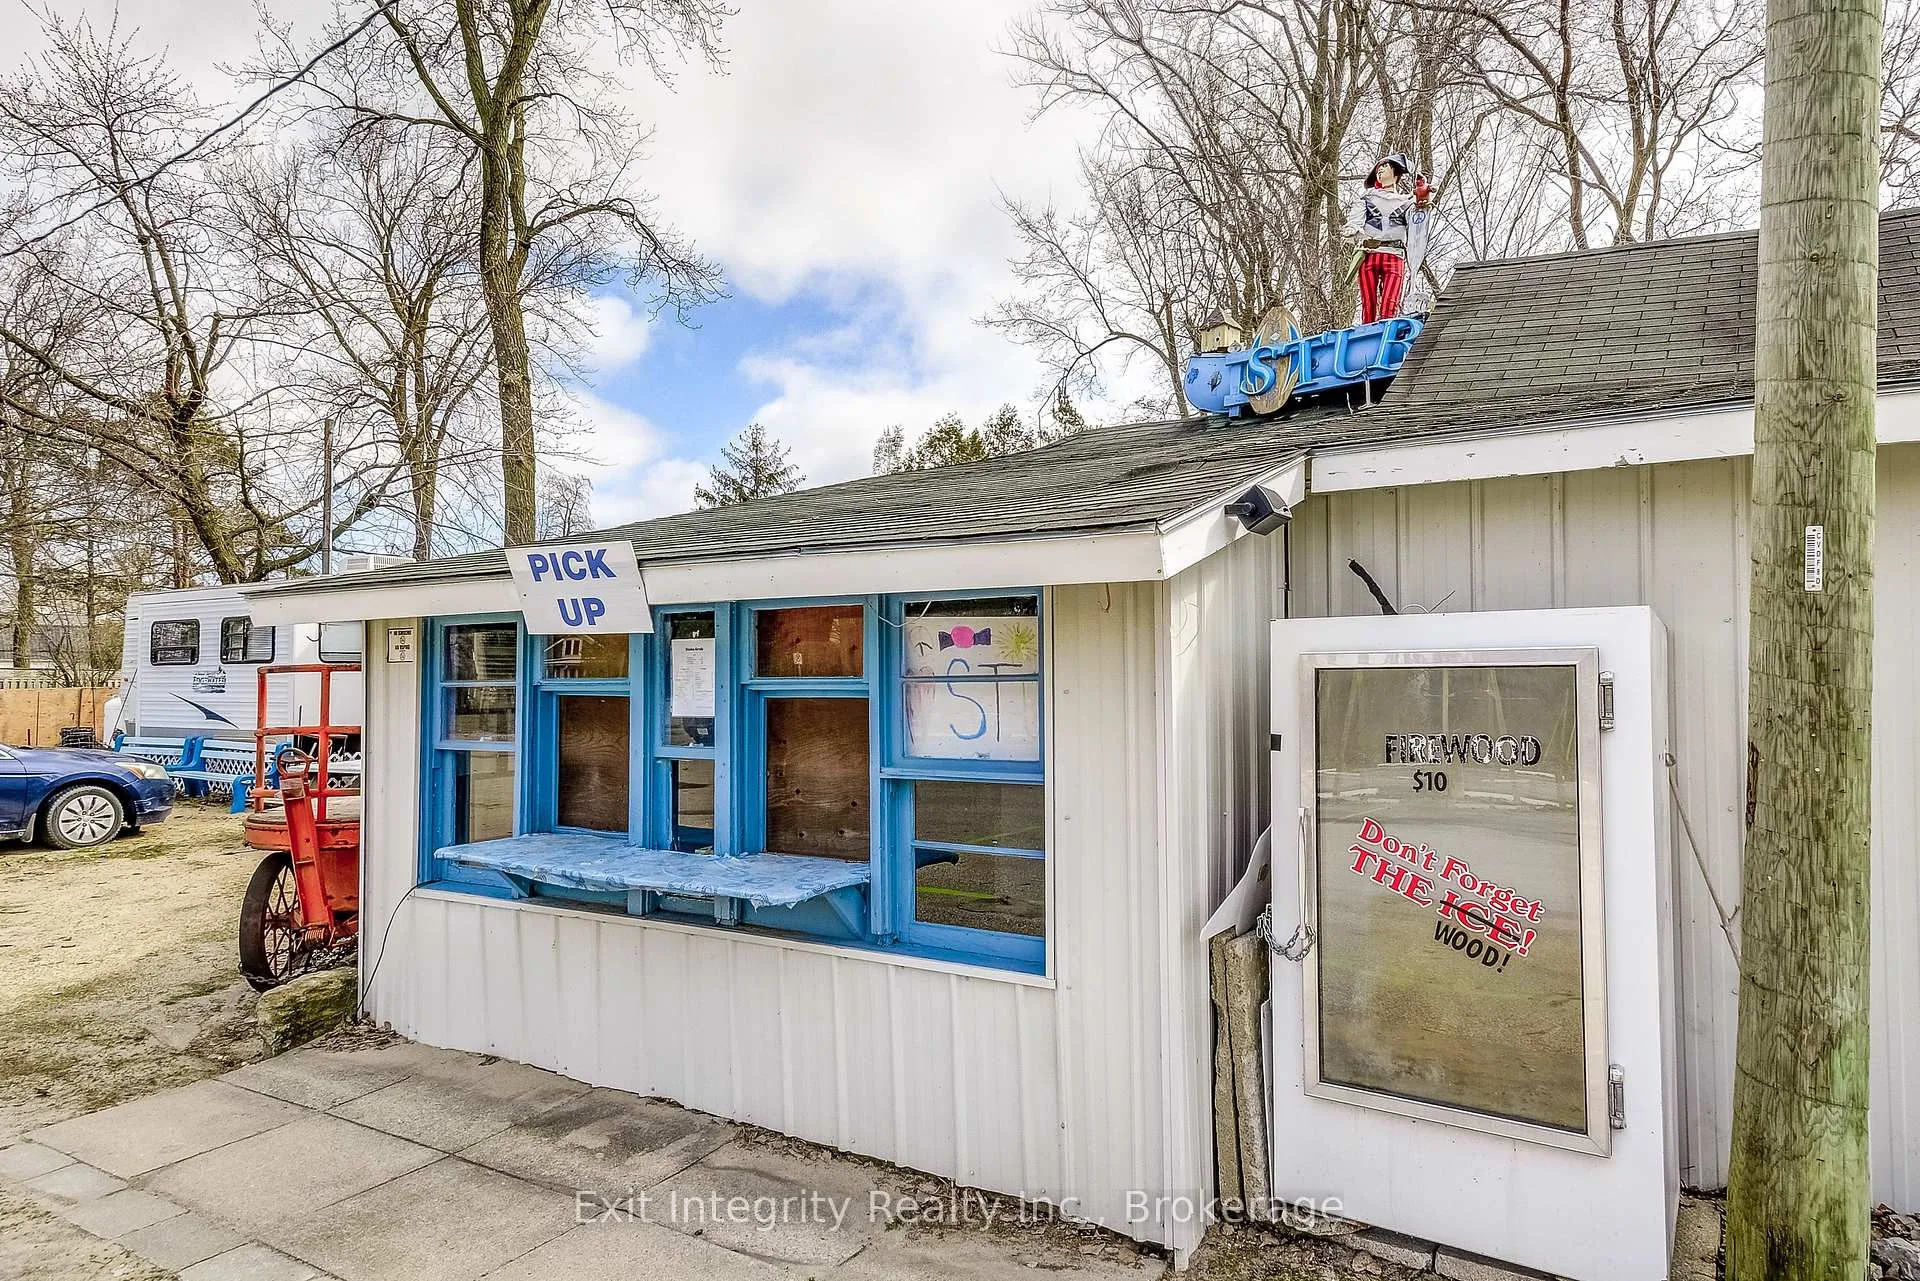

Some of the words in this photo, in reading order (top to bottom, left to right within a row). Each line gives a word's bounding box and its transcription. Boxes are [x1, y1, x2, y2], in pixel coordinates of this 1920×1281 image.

[527, 549, 617, 582] PICK
[557, 597, 606, 627] UP
[1385, 734, 1542, 766] FIREWOOD
[1412, 769, 1448, 793] $10
[1357, 817, 1438, 871] Don't
[1439, 856, 1545, 923] Forget
[1349, 845, 1435, 908] THE
[1437, 890, 1537, 957] ICE!
[1434, 920, 1511, 973] WOOD!
